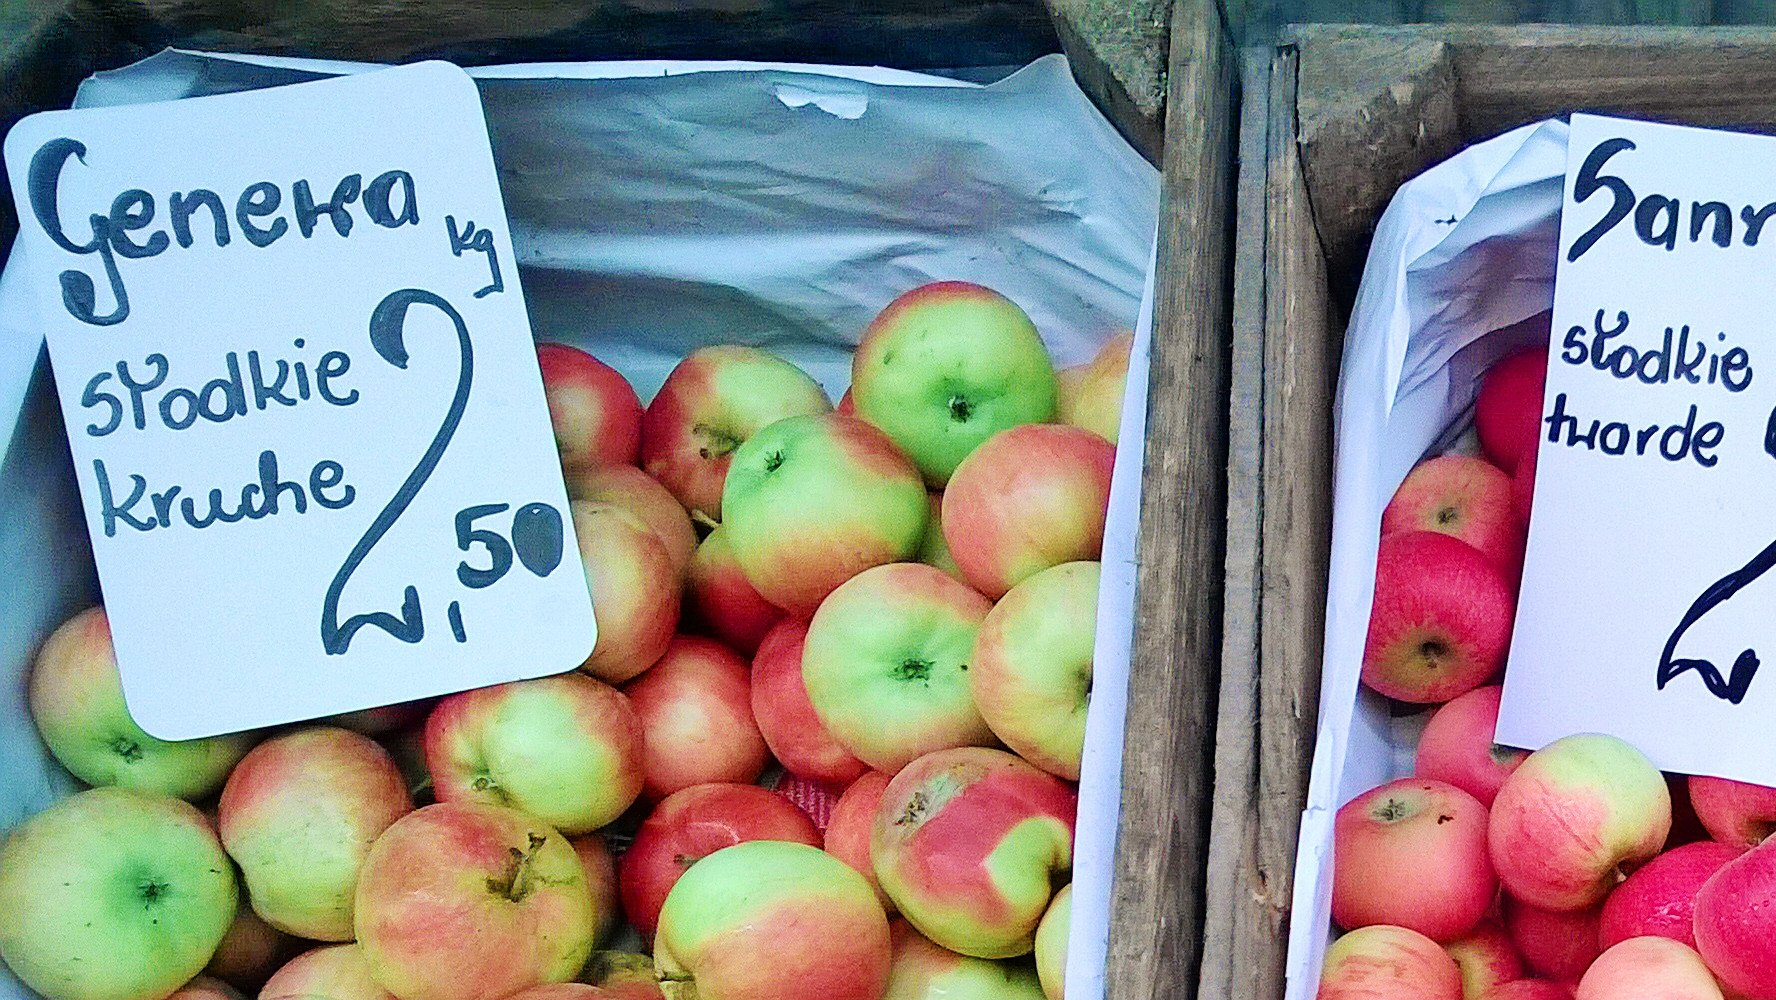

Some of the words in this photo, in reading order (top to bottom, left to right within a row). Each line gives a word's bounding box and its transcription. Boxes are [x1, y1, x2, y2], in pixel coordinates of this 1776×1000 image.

[28, 137, 420, 326] Genewa
[446, 215, 505, 298] kg
[1561, 308, 1754, 393] słodkie
[1544, 393, 1725, 468] twarde
[93, 449, 355, 536] kruche
